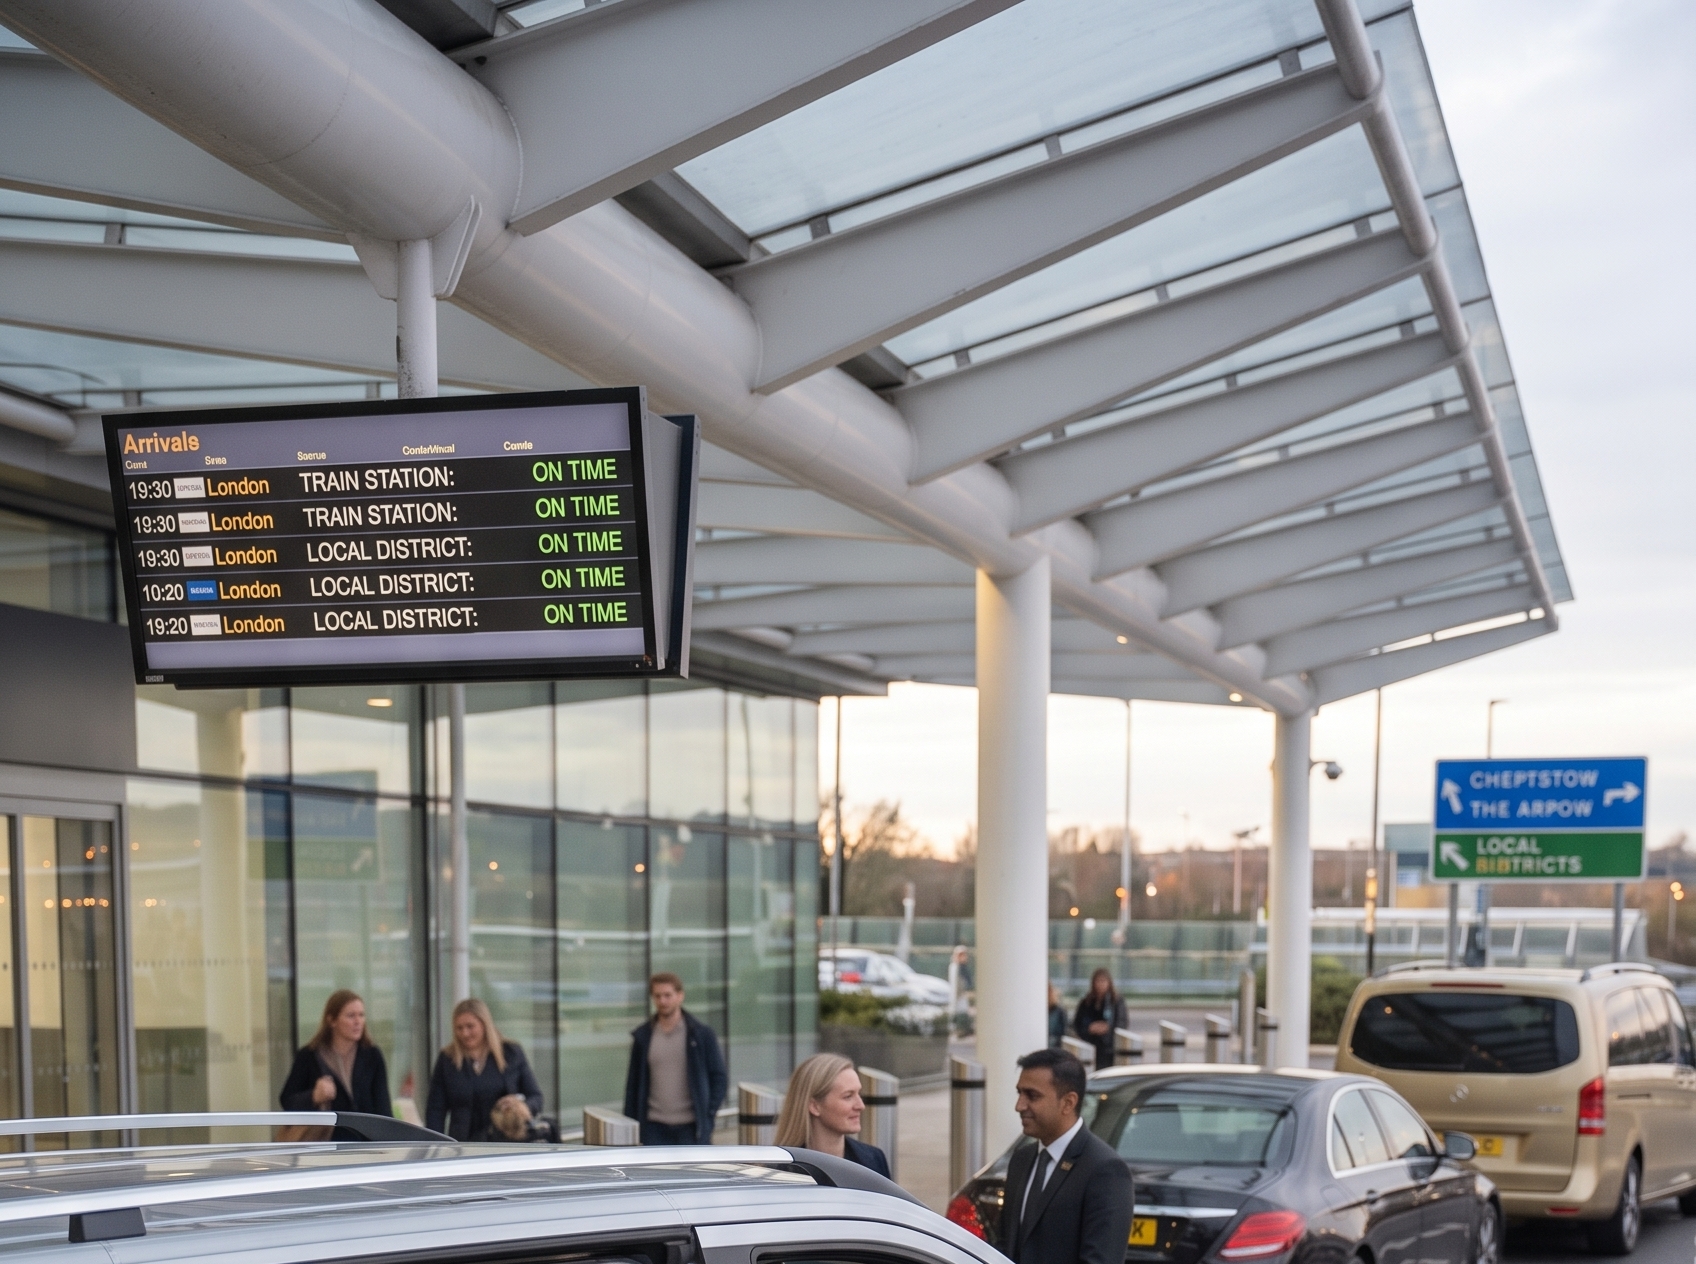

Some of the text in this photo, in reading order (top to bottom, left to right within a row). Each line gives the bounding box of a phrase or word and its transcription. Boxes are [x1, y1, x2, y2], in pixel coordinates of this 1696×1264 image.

[123, 431, 200, 454] Arrivals
[129, 481, 172, 500] 19:30
[207, 476, 270, 497] London
[299, 470, 360, 493] TRAIN
[364, 466, 455, 490] STATION:
[532, 460, 564, 483] ON
[567, 458, 617, 480] TIME
[133, 515, 177, 533] 19:30
[211, 511, 274, 531] London
[303, 505, 362, 527] TRAIN
[367, 502, 458, 525] STATION:
[535, 497, 566, 518] ON
[570, 494, 620, 516] TIME
[137, 549, 180, 567] 19:30
[214, 545, 278, 566] London
[306, 540, 372, 563] LOCAL
[376, 536, 473, 559] DISTRICT:
[538, 533, 569, 553] ON
[573, 530, 623, 552] TIME
[142, 566, 625, 601] 10:20 London LOCAL DISTRICT: ON TIME
[146, 601, 628, 636] 19:20 London LOCAL DISTRICT: ON TIME
[1469, 769, 1600, 790] CHEPTSTOW
[1469, 799, 1511, 819] THE
[1476, 837, 1542, 855] LOCAL
